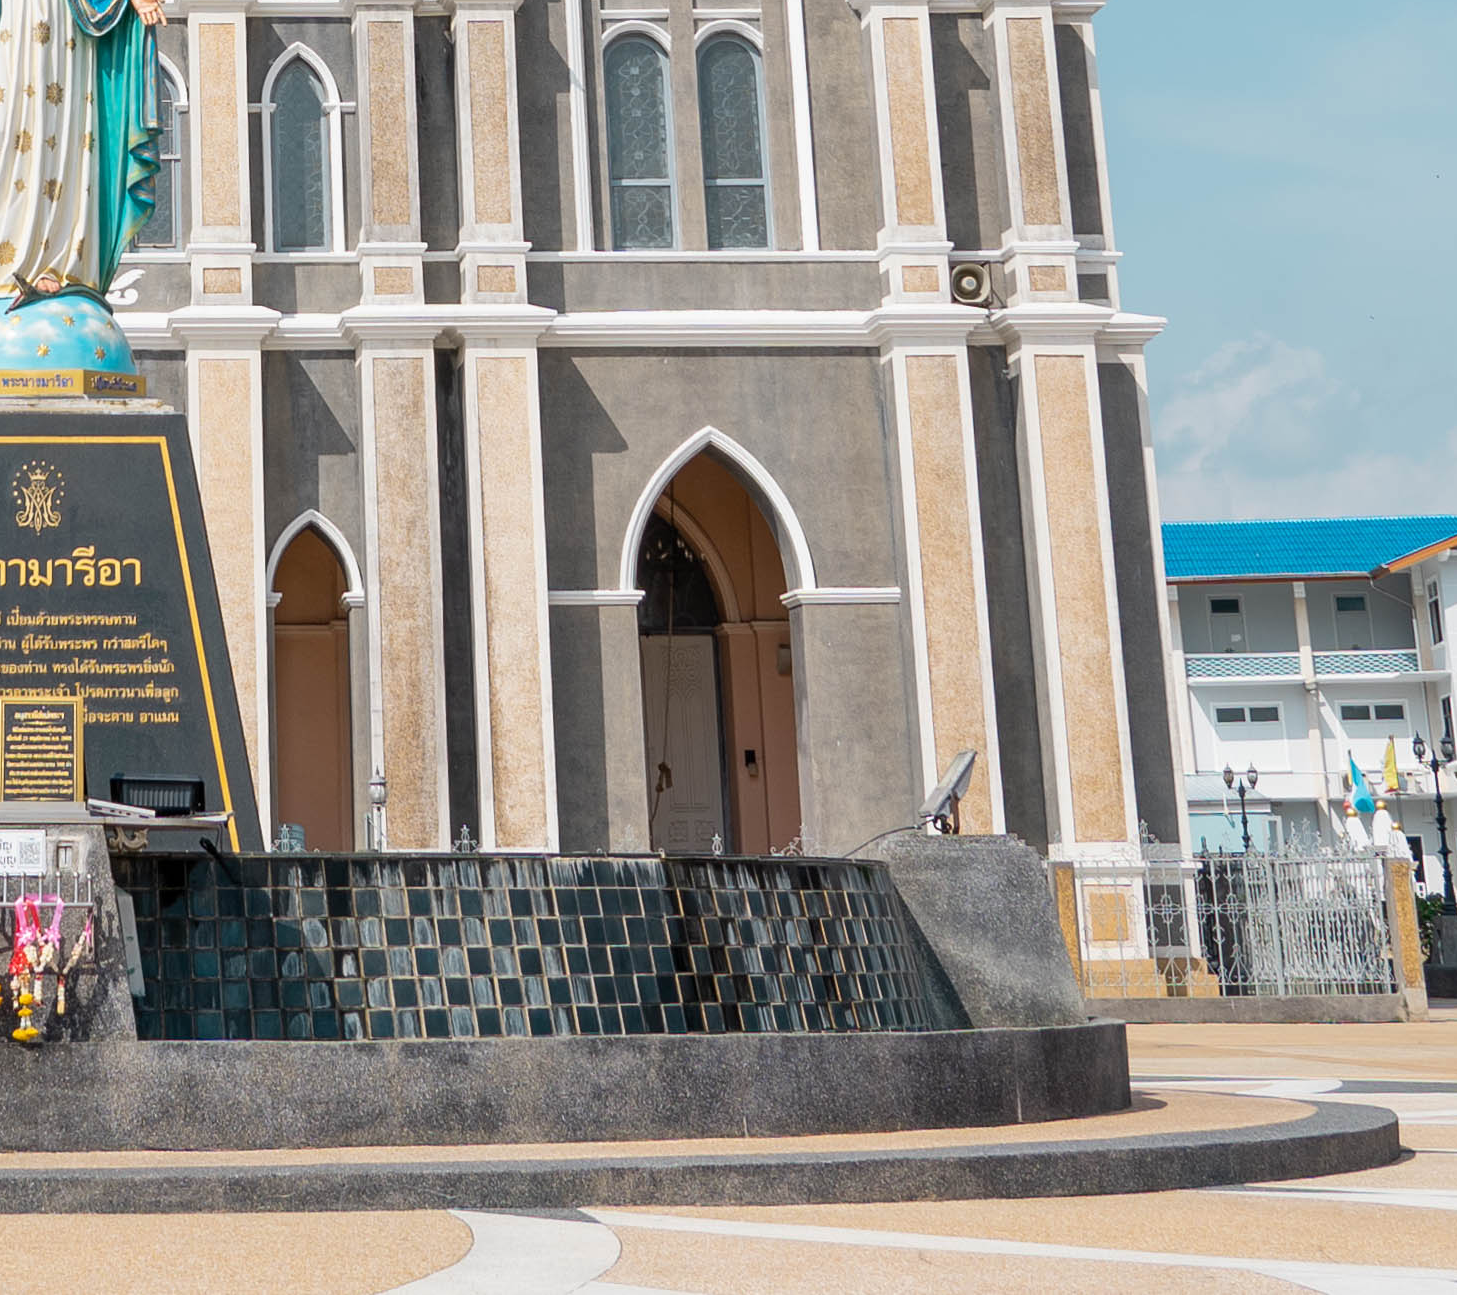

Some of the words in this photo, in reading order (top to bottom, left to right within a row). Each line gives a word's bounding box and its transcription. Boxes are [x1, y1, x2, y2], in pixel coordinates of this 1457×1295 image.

[6, 605, 137, 627] เปี่ยมด้วยพระหรรษทาน
[21, 633, 98, 655] ผู้ได้รับพระพร
[102, 632, 168, 652] กว่าสตรีใดๆ
[51, 656, 175, 675] ทรงได้รับพระพรยิ่งนัก
[139, 711, 180, 723] อาแมน
